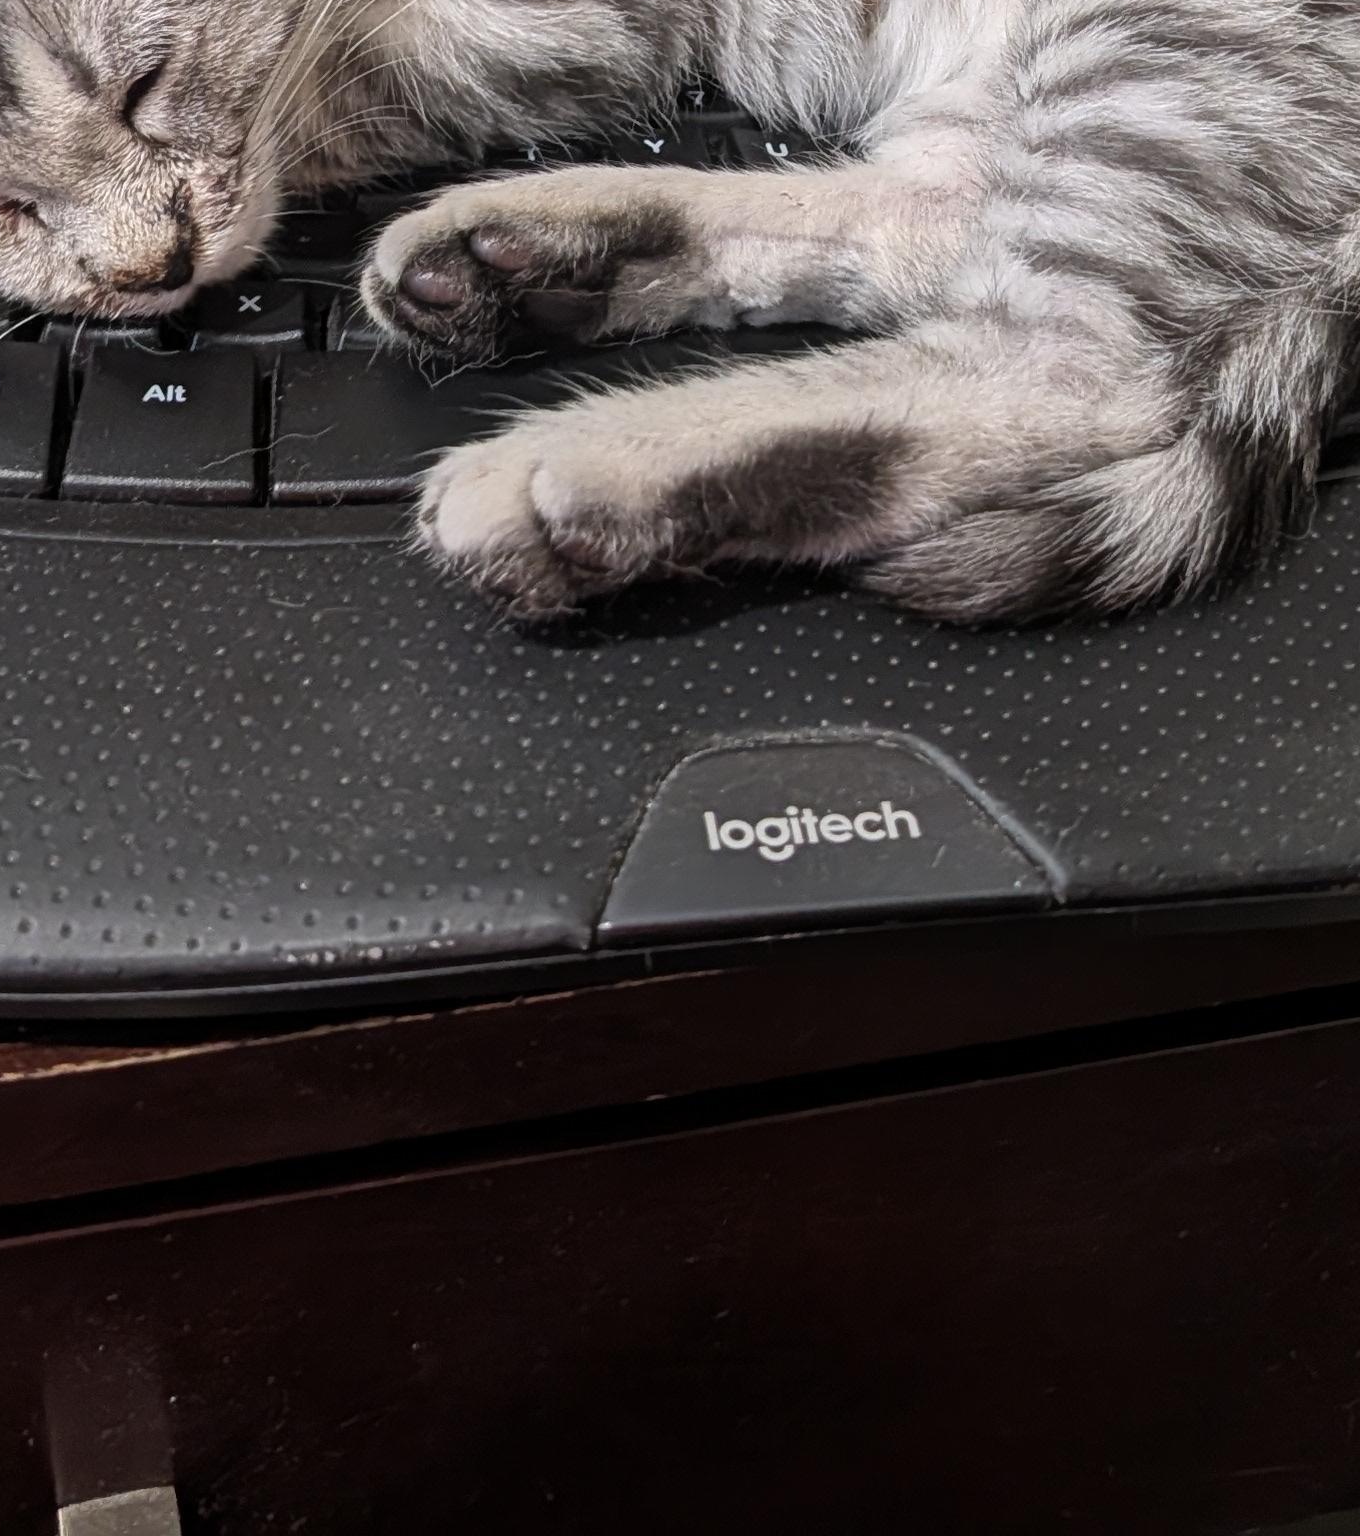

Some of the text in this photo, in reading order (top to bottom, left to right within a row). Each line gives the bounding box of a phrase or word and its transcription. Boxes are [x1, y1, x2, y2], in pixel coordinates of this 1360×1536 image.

[643, 139, 665, 154] Y
[766, 142, 789, 157] U
[239, 295, 262, 312] X
[142, 384, 187, 402] Alt
[703, 800, 921, 862] logitech
